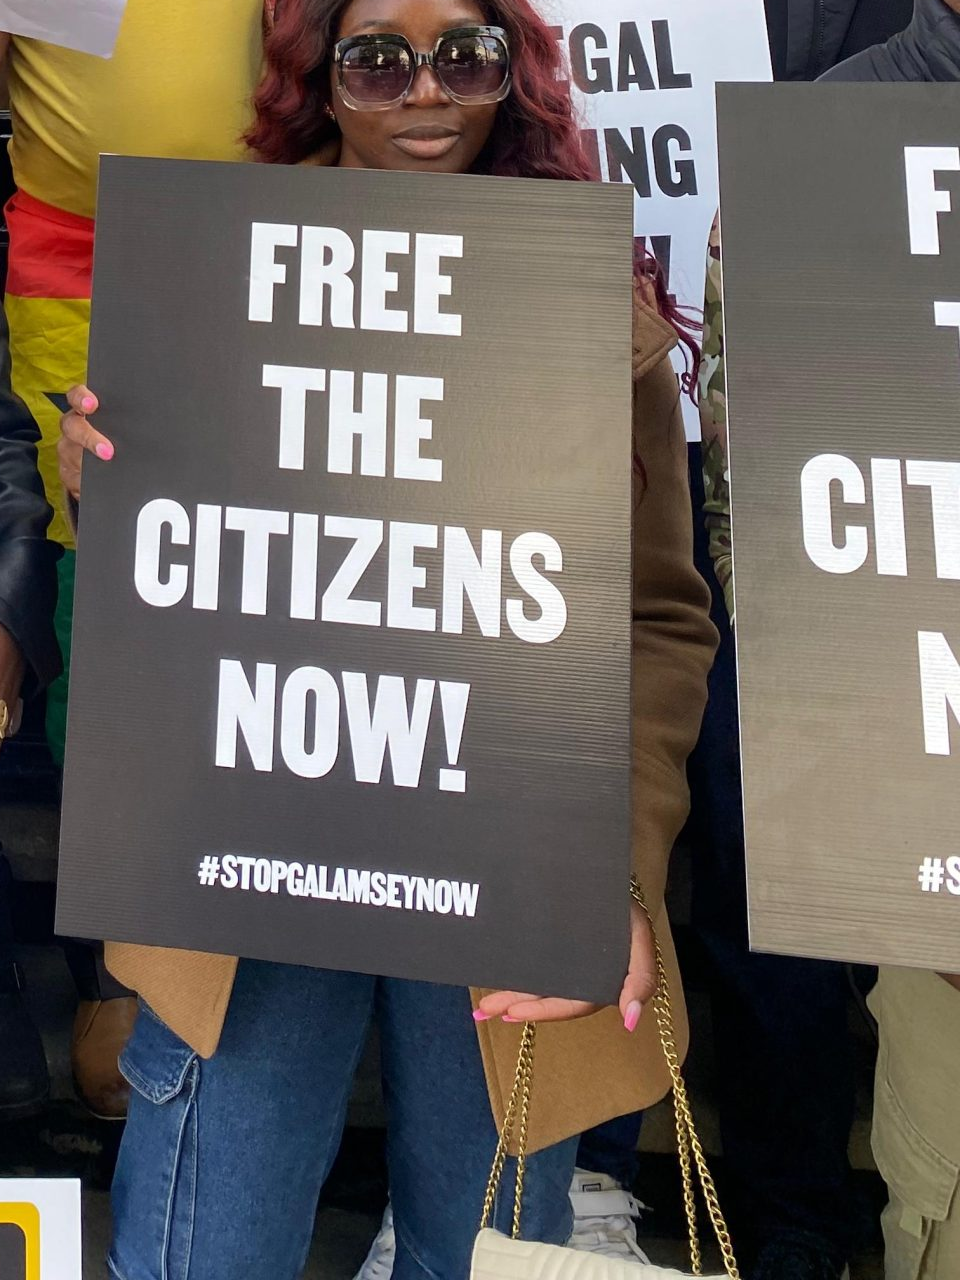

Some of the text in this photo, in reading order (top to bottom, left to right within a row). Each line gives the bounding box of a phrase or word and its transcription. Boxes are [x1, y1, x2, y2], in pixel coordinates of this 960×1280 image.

[248, 222, 464, 338] FREE
[262, 364, 444, 482] THE
[132, 497, 569, 645] CITIZENS
[214, 659, 472, 794] NOW!
[198, 853, 480, 918] #STOPGALAMSEYNOW
